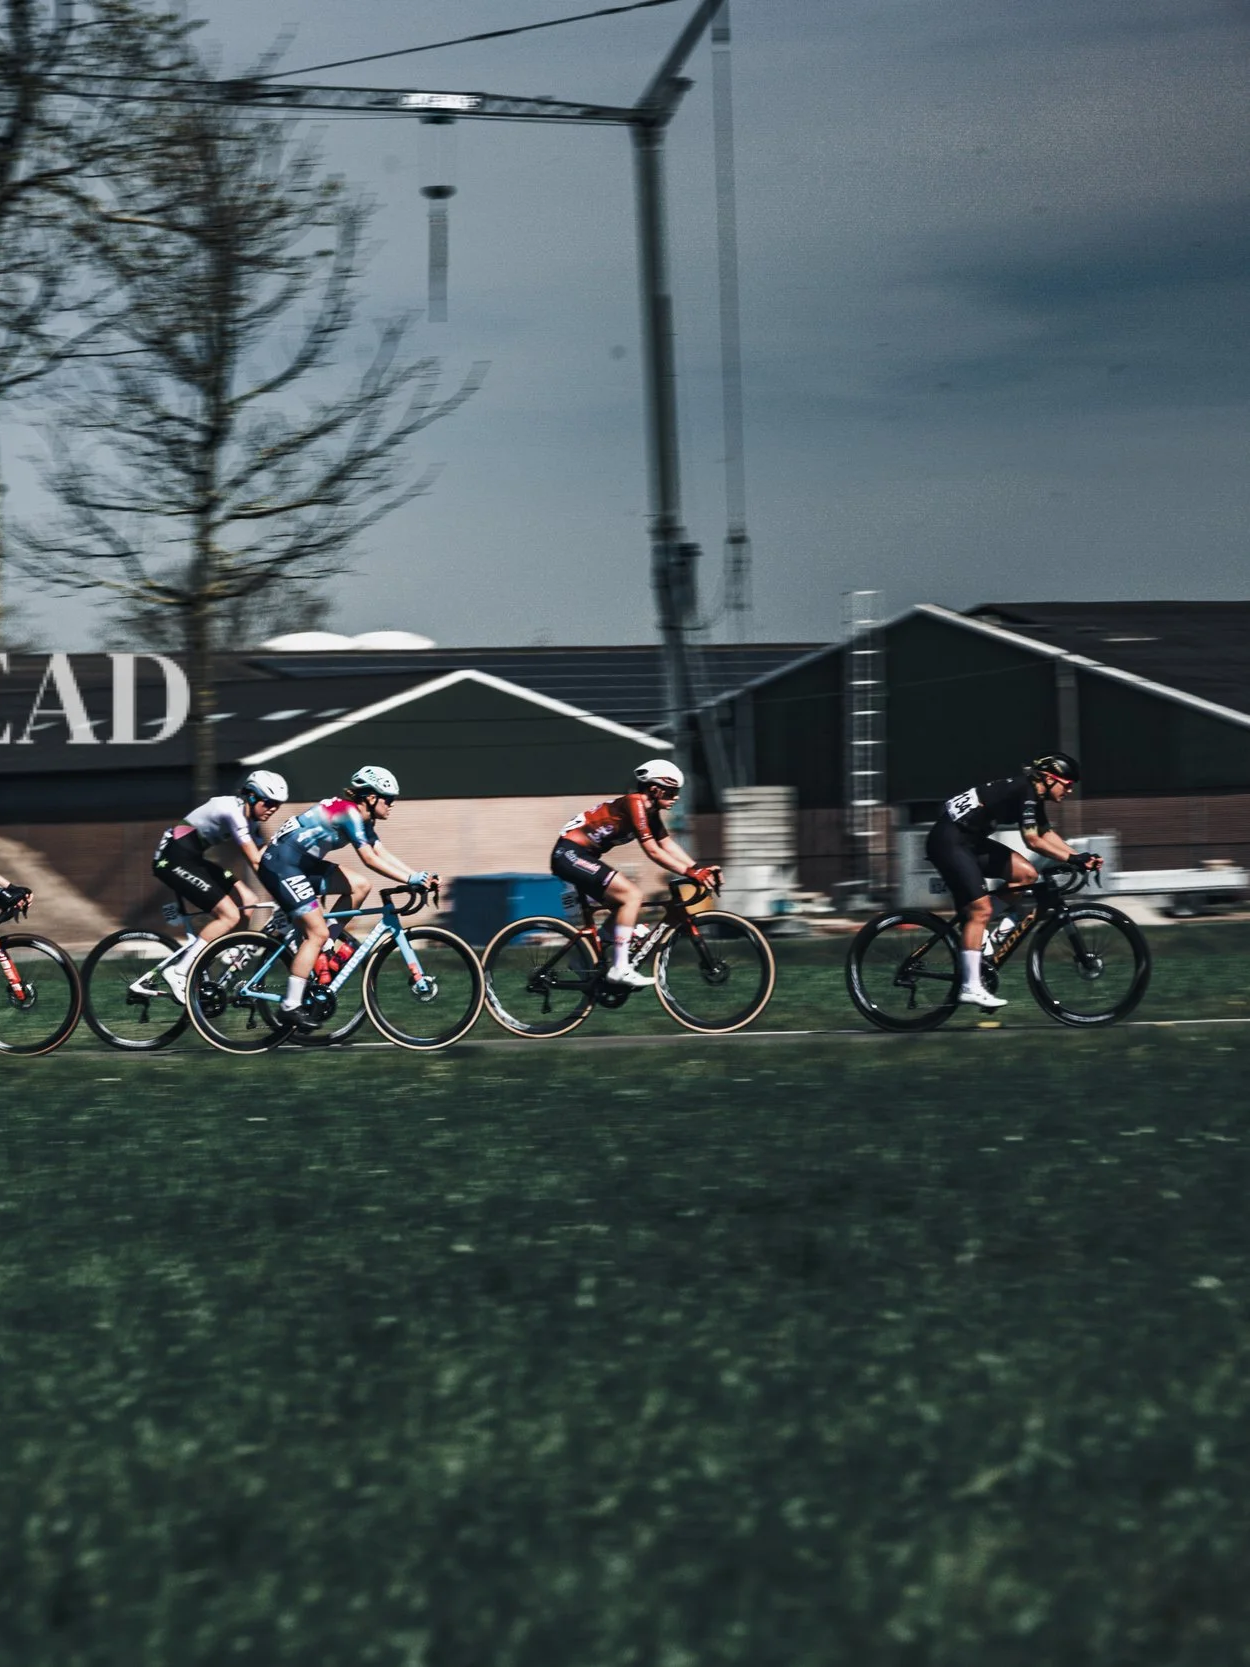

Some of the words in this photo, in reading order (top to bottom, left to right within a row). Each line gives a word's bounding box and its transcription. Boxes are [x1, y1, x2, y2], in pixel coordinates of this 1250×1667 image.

[953, 793, 973, 814] 134
[285, 874, 316, 901] AAB
[329, 920, 388, 993] HANDSLING
[993, 907, 1038, 964] RIDLEY
